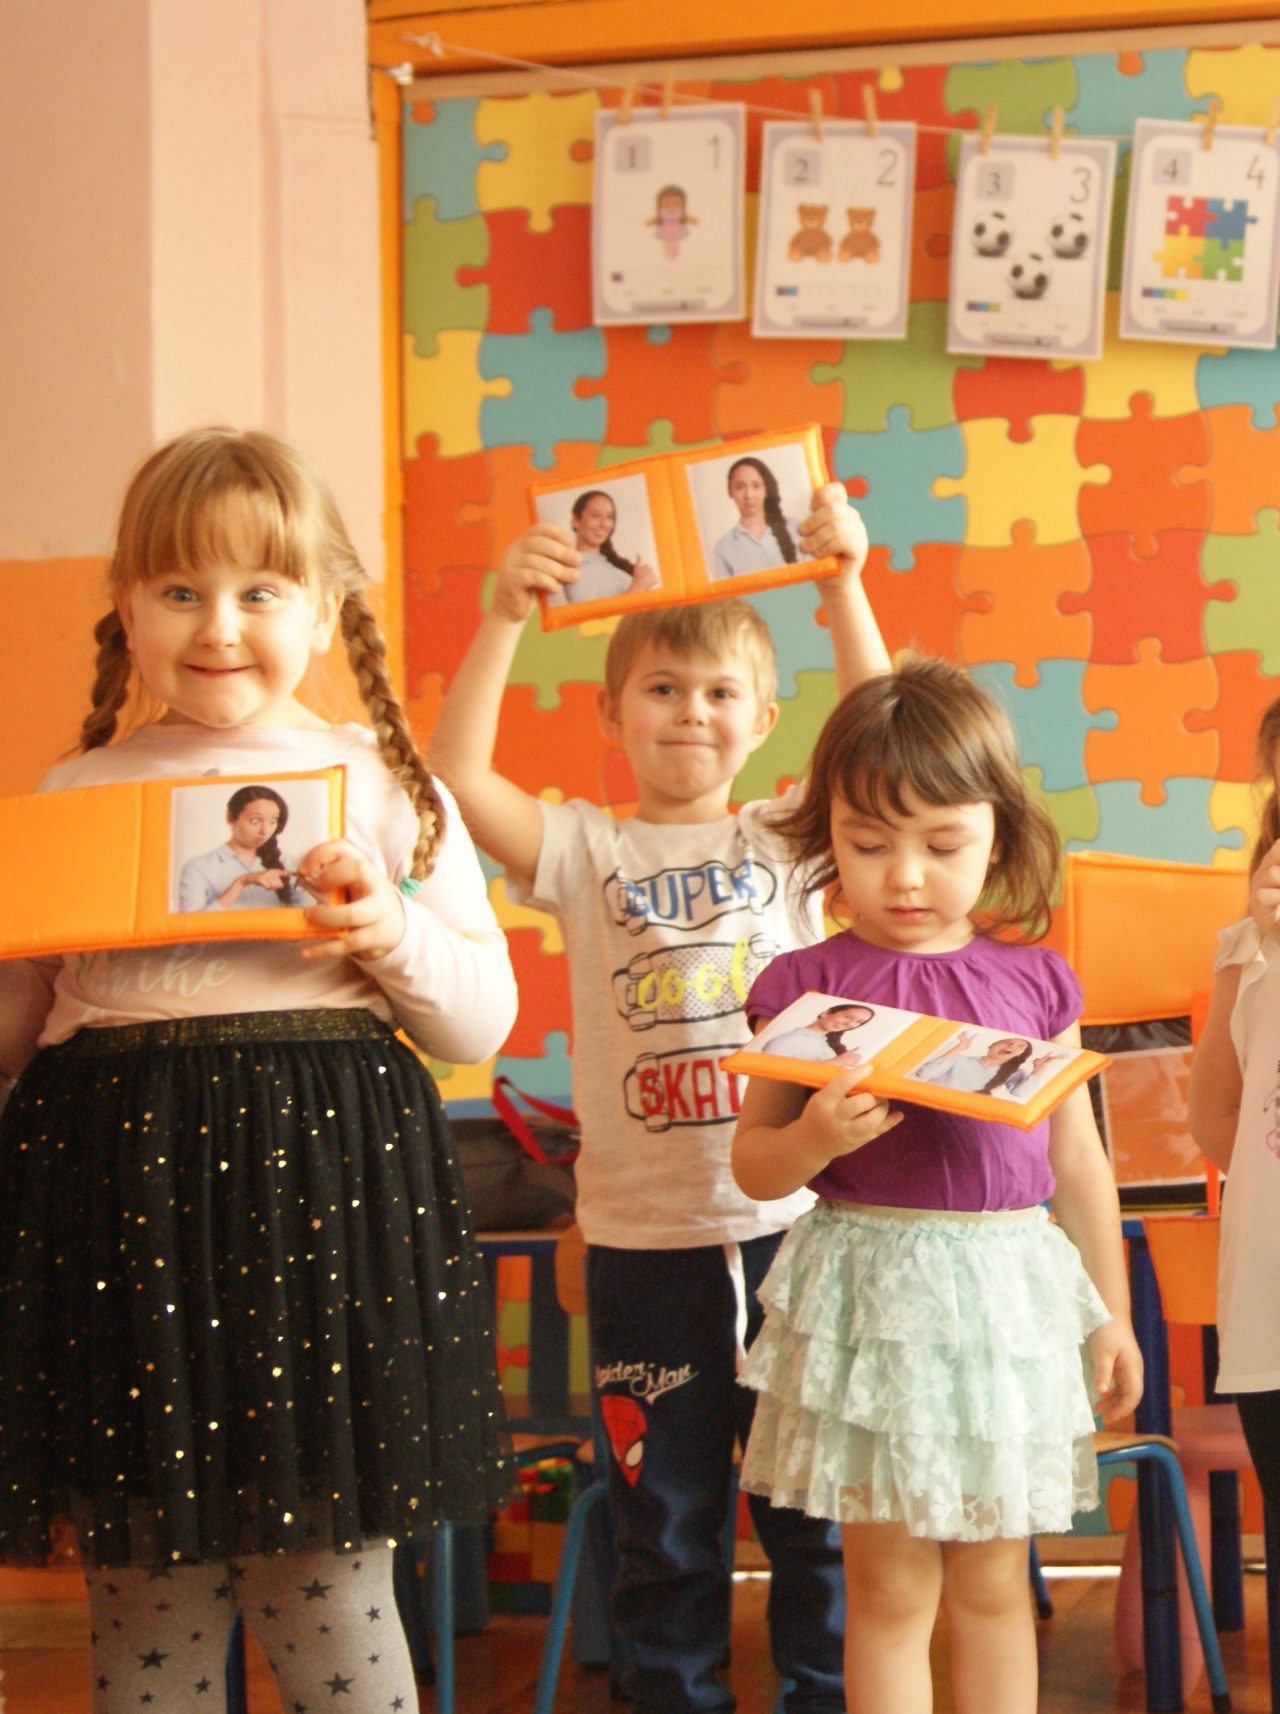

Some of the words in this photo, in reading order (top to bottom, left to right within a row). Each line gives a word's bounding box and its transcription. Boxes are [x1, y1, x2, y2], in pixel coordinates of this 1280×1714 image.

[708, 134, 721, 171] 1
[794, 158, 809, 183] 2
[876, 148, 898, 188] 2
[1162, 157, 1179, 182] 4
[986, 171, 1002, 197] 3
[1069, 166, 1092, 204] 3
[1245, 153, 1265, 190] 4
[625, 859, 758, 921] SUPER
